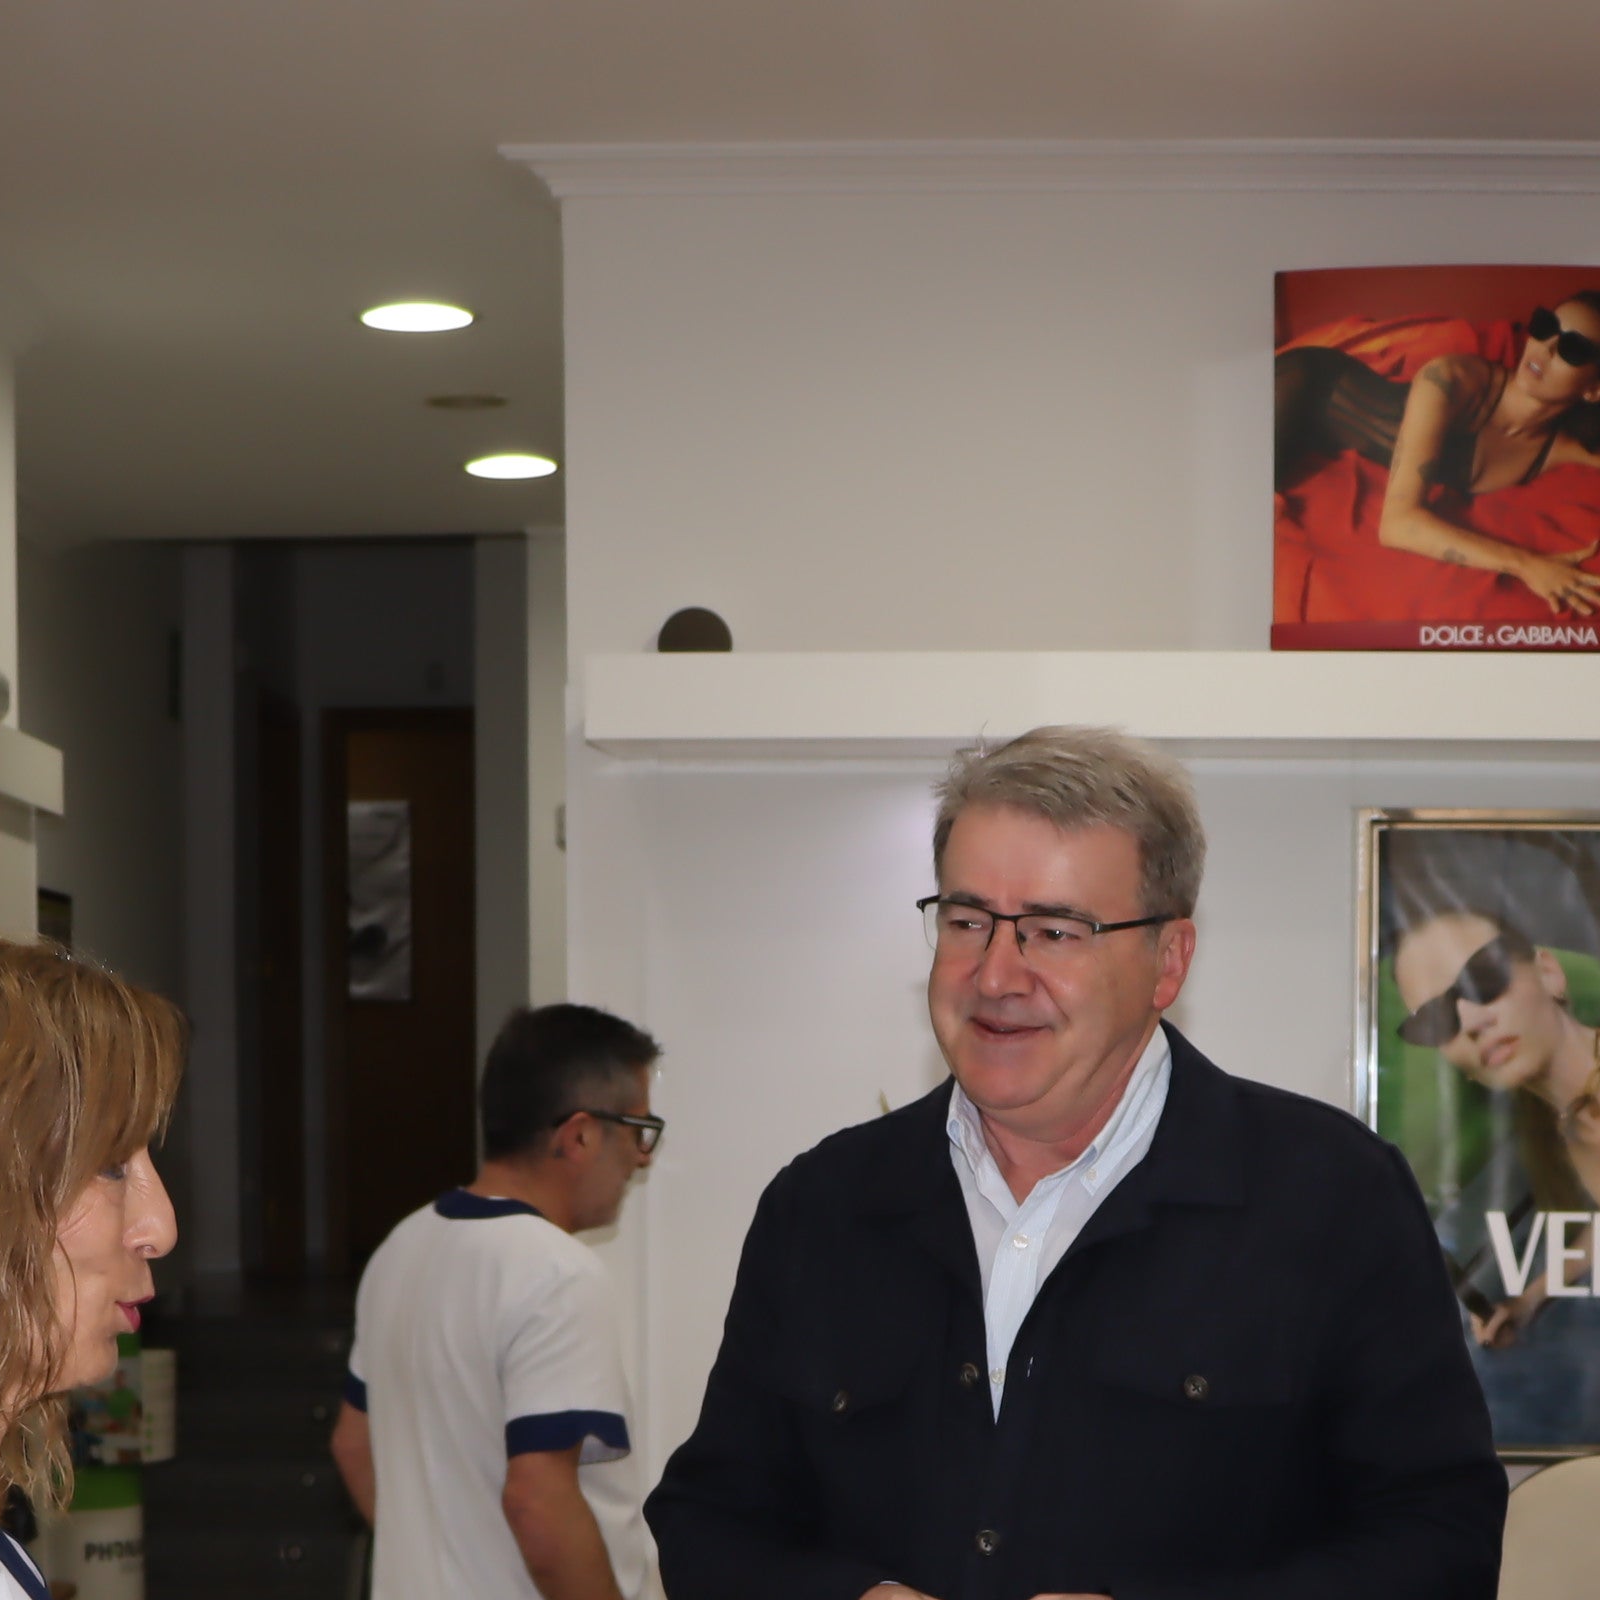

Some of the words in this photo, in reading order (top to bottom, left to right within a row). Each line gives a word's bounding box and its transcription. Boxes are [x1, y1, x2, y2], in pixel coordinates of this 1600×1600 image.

[1419, 625, 1484, 646] DOLCE
[1486, 633, 1495, 645] &
[1497, 625, 1599, 646] GABBANA
